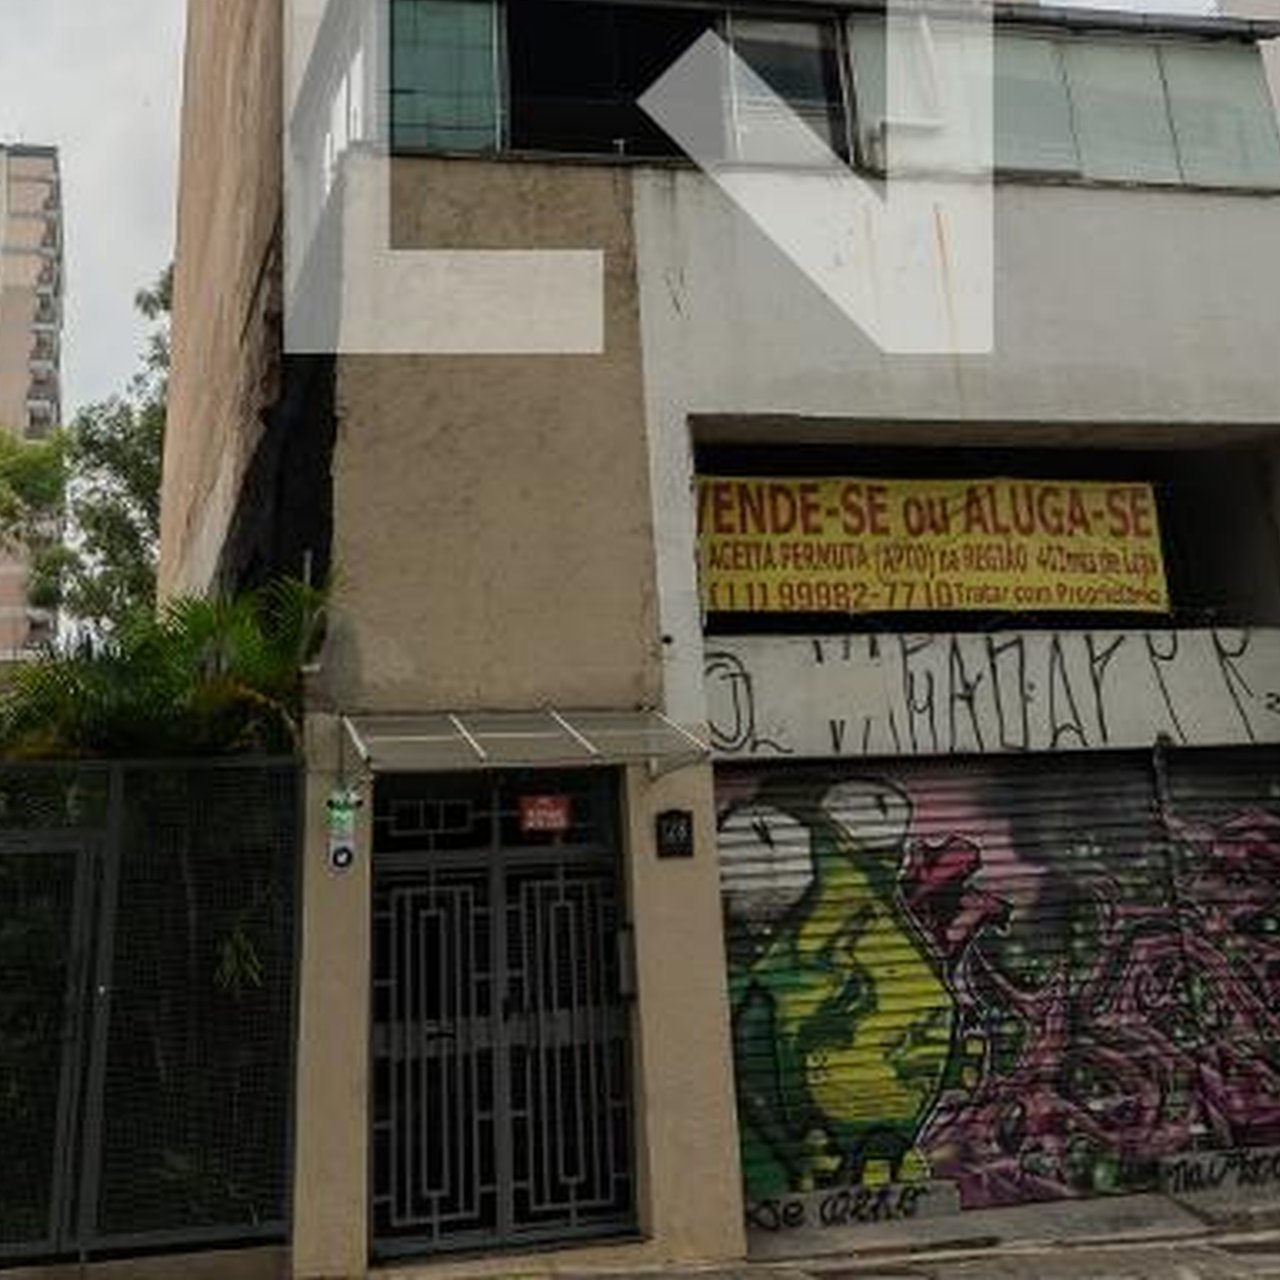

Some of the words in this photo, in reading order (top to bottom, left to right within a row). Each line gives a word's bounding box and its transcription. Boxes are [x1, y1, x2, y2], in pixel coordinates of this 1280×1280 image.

[903, 496, 950, 536] ou
[964, 484, 1153, 538] ALUGA-SE
[709, 541, 777, 571] ACEITA
[779, 541, 870, 571] PERMUTA
[1012, 584, 1053, 605] com
